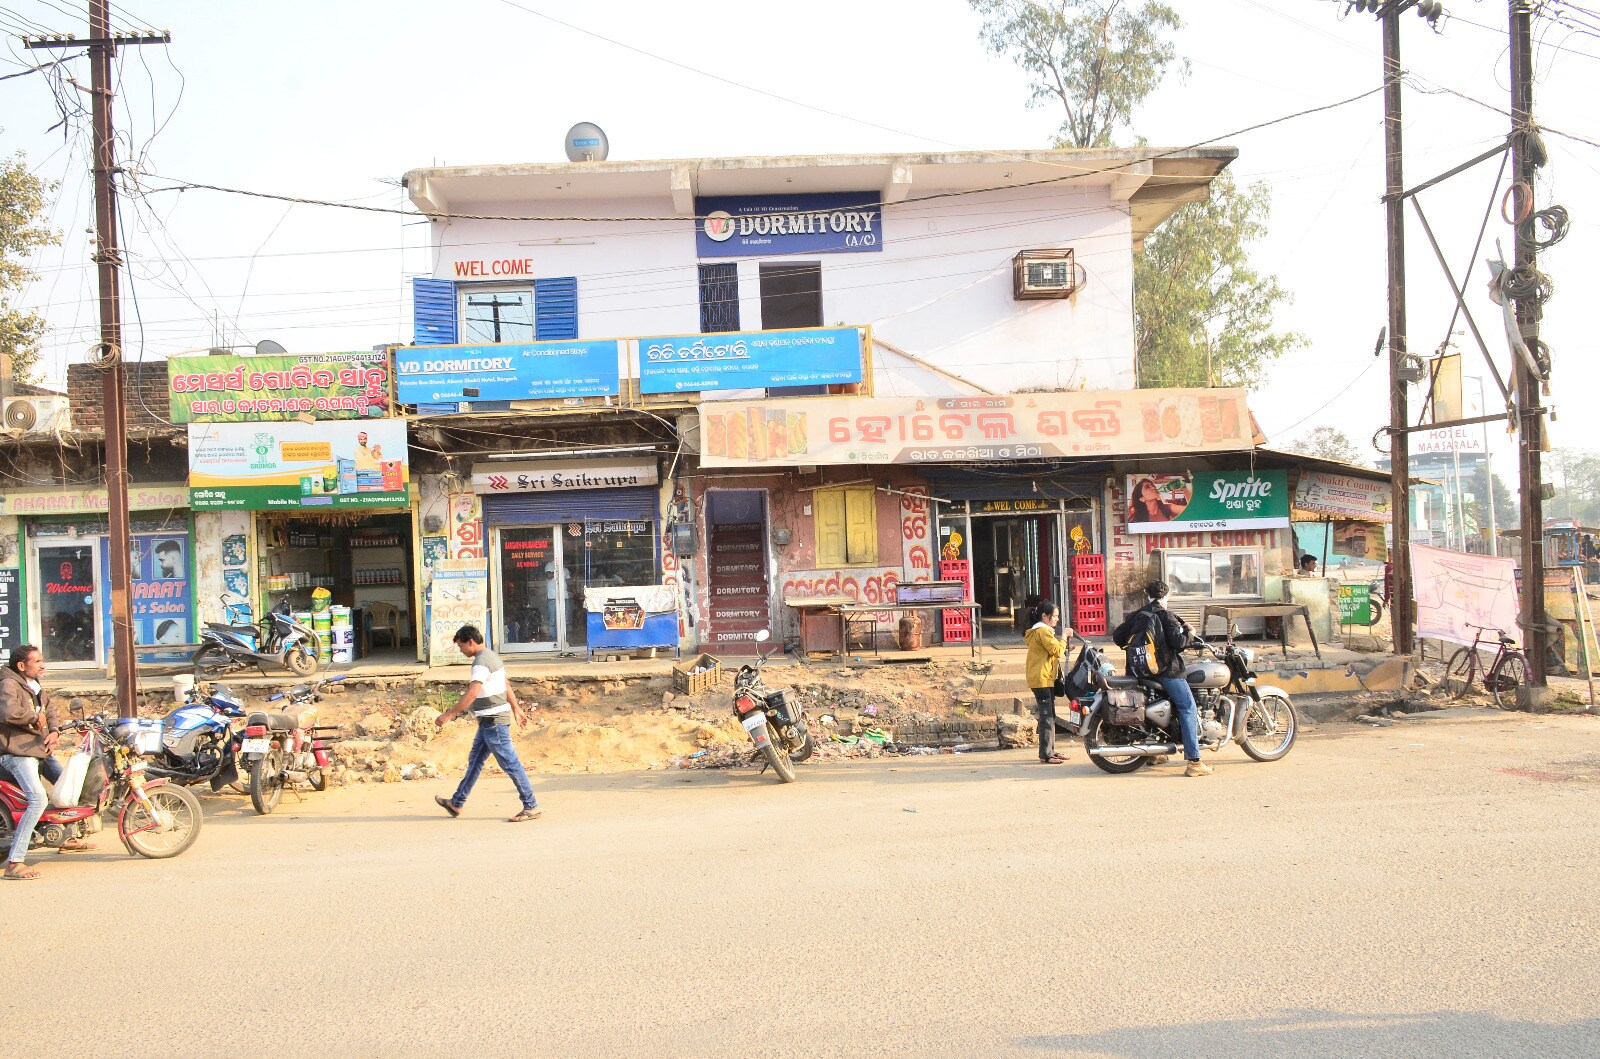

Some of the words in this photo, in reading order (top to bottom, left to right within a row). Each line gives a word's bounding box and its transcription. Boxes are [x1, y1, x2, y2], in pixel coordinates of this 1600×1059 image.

[740, 212, 876, 236] DORMITORY
[398, 361, 420, 373] VD
[423, 357, 514, 372] DORMITORY
[339, 368, 386, 397] ସାହୁ
[222, 400, 236, 413] ଓ
[828, 412, 1018, 444] ହୋଟେଲ
[1036, 400, 1122, 437] ଶକ୍ତି
[1430, 429, 1467, 440] HOTEL
[998, 448, 1010, 458] ଓ
[1016, 444, 1042, 458] ମିଠା
[518, 474, 546, 489] Sri
[551, 472, 638, 488] Saikrupa
[1346, 477, 1382, 492] Counter
[1209, 476, 1272, 502] Sprite
[12, 495, 80, 510] BHARAT
[136, 492, 184, 507] Salon
[994, 501, 1010, 511] WEL
[1014, 500, 1037, 510] COME
[1296, 502, 1340, 512] COUNTER
[716, 564, 760, 572] DORMITORY
[46, 582, 92, 593] Welcome
[716, 586, 760, 595] DORMITORY
[149, 602, 186, 614] Salon
[716, 610, 760, 618] DORMITORY
